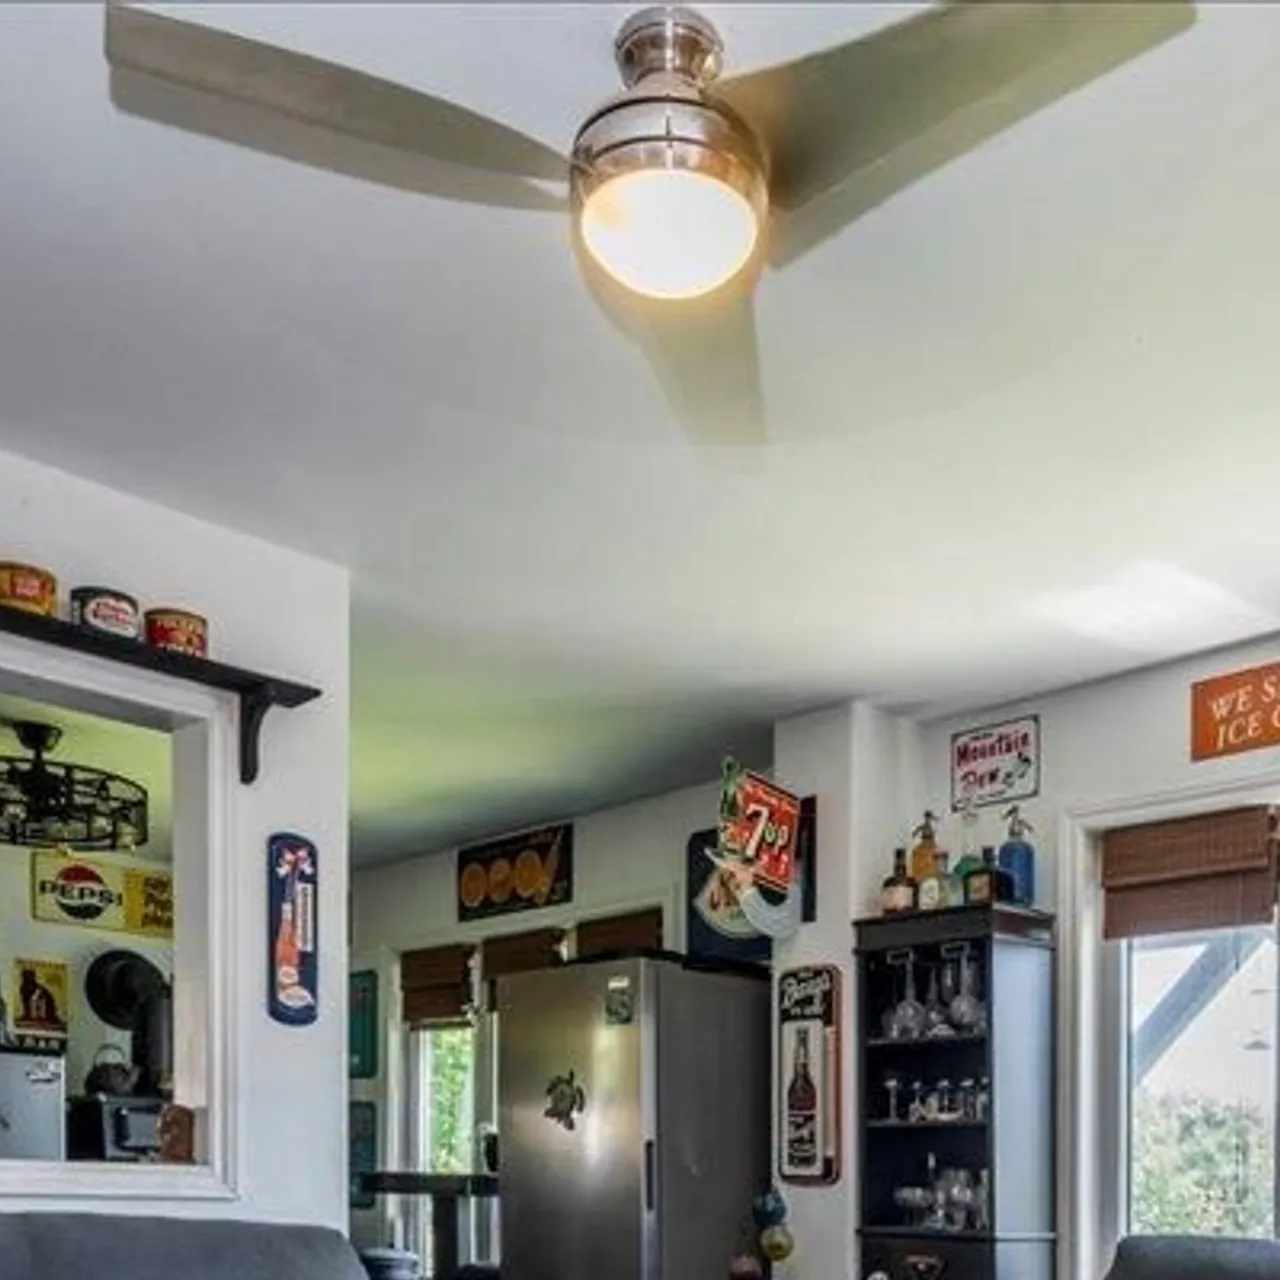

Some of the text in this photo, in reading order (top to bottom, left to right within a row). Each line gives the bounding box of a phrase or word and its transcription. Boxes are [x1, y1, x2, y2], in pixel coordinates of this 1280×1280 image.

[1209, 684, 1254, 721] WE
[1216, 710, 1265, 751] ICE
[38, 879, 123, 907] PEPSI
